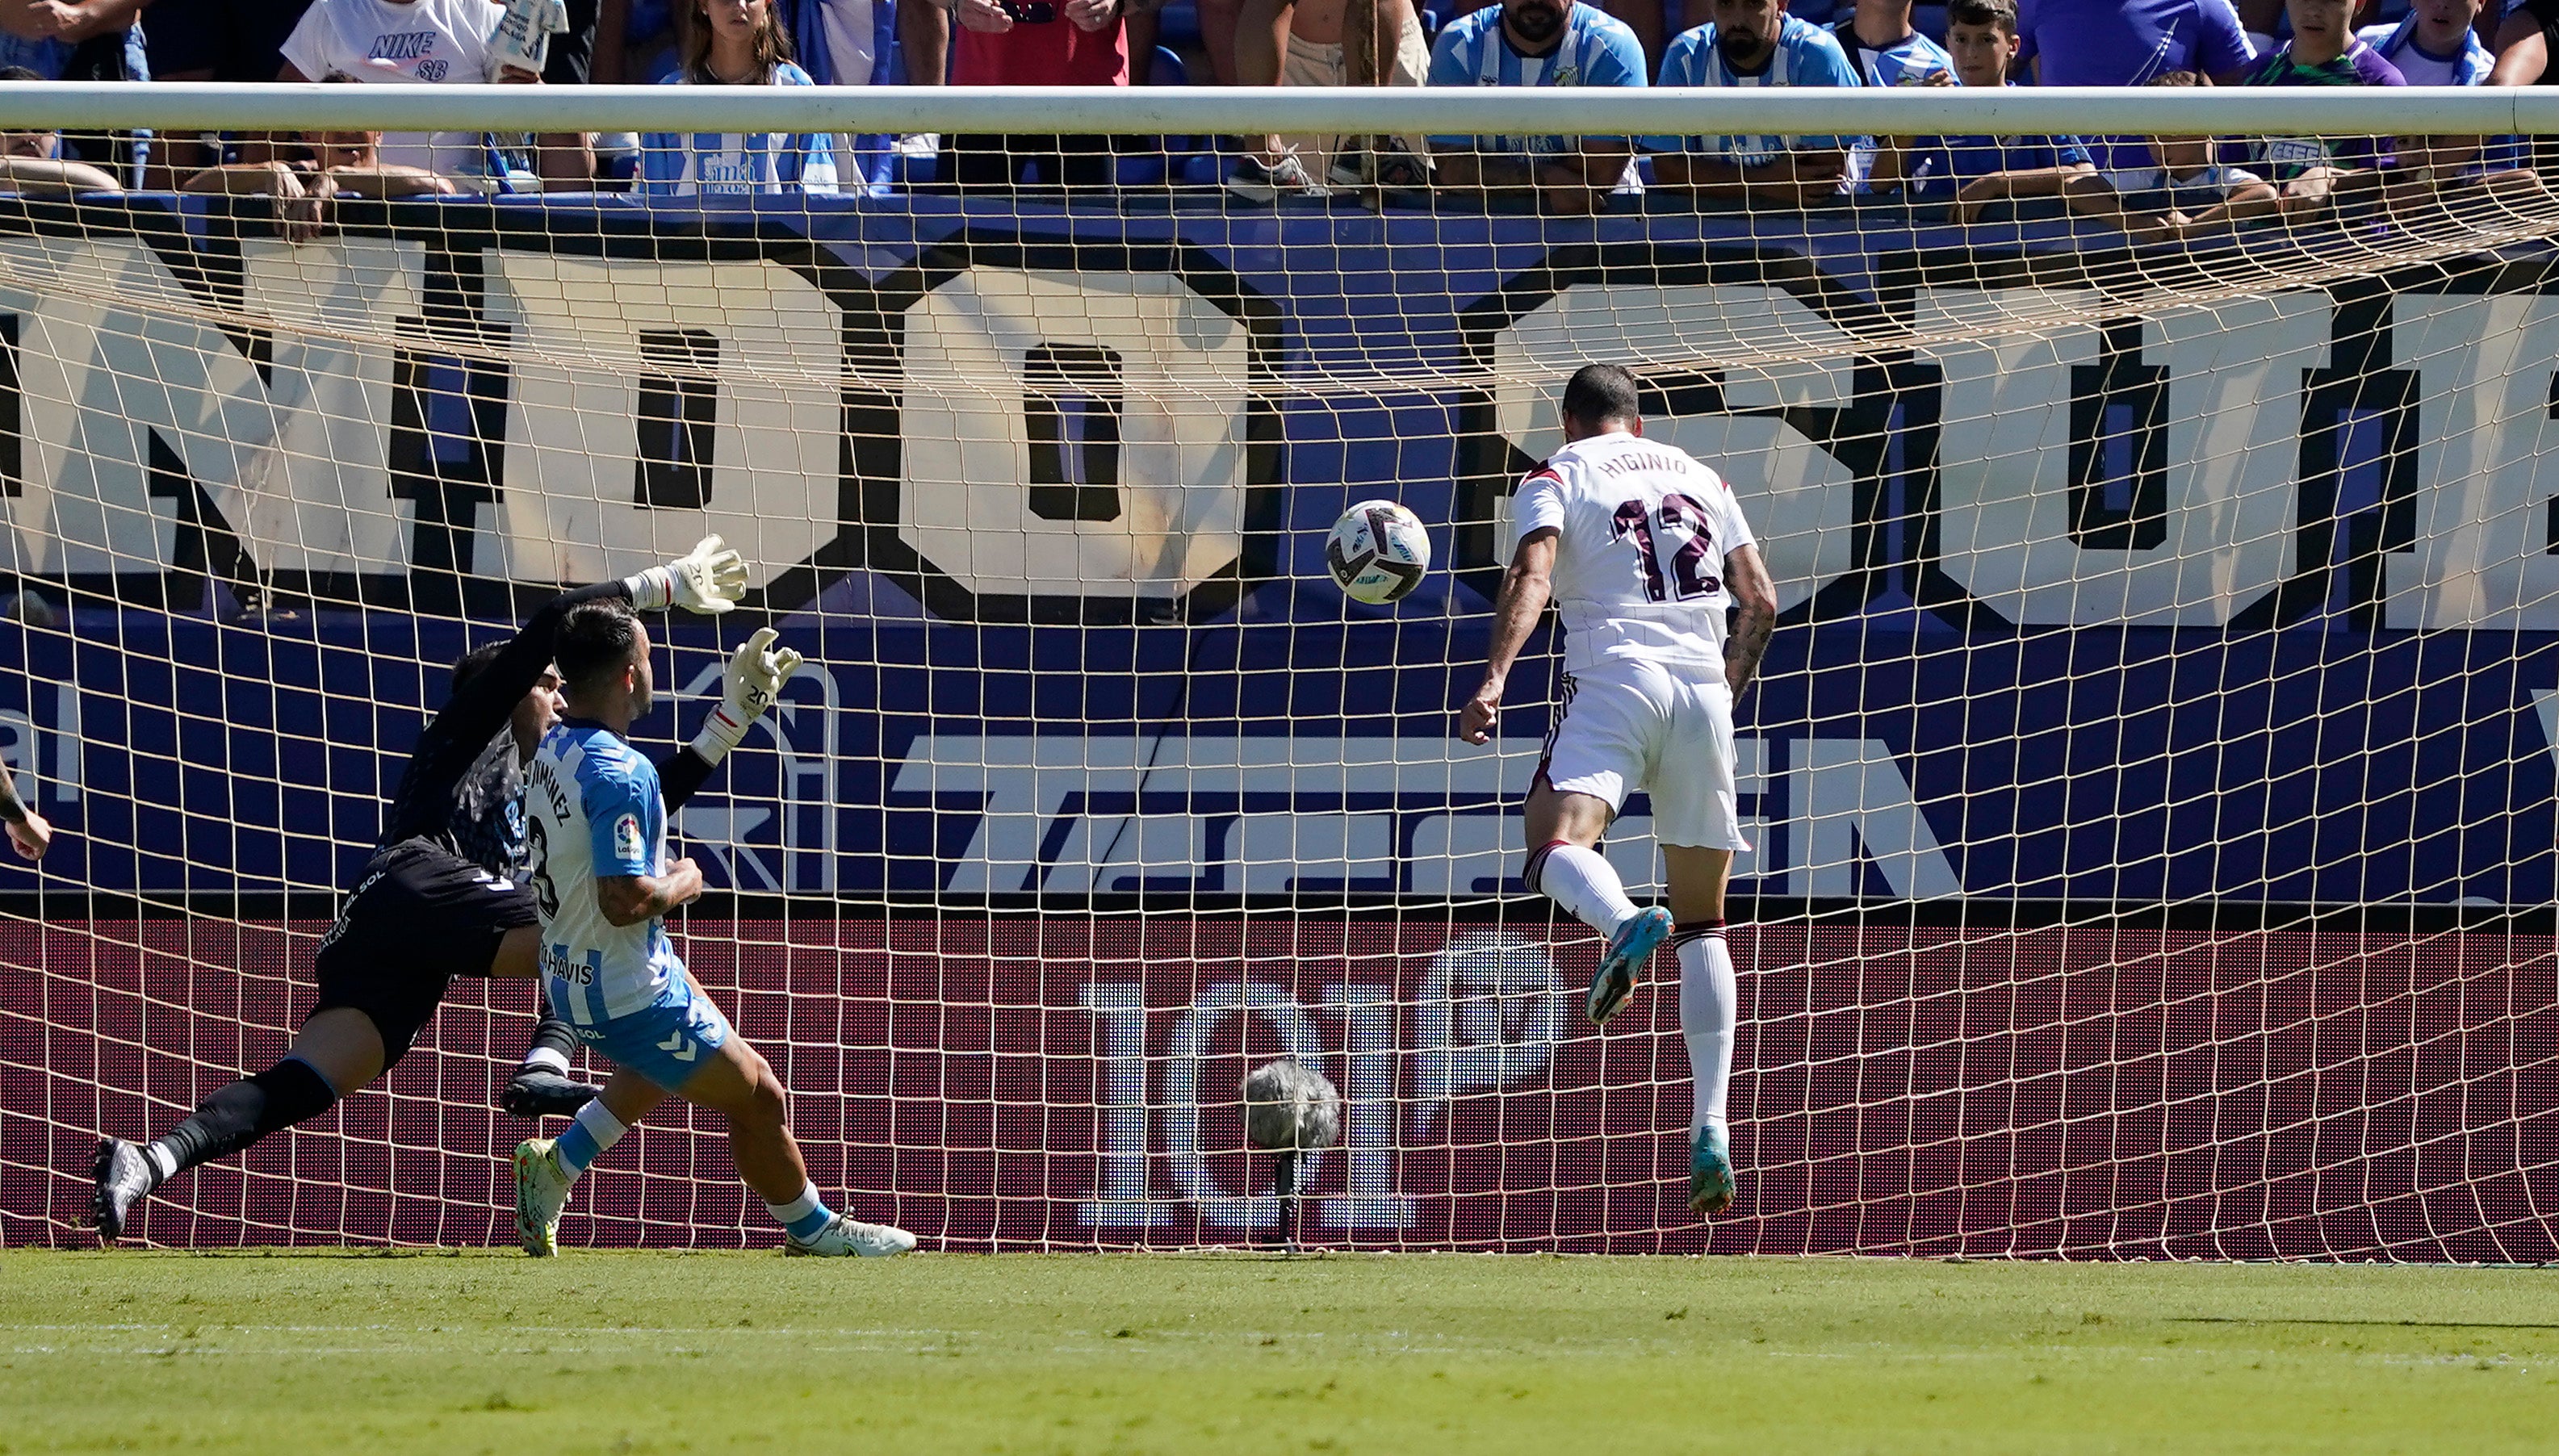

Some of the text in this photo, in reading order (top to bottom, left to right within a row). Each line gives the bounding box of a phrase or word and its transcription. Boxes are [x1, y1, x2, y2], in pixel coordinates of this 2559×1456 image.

[369, 31, 436, 58] NIKE
[417, 60, 449, 80] SB
[1598, 452, 1686, 478] HIGINIO
[1609, 494, 1720, 604] 12
[745, 684, 769, 705] 20
[359, 871, 386, 893] SOL
